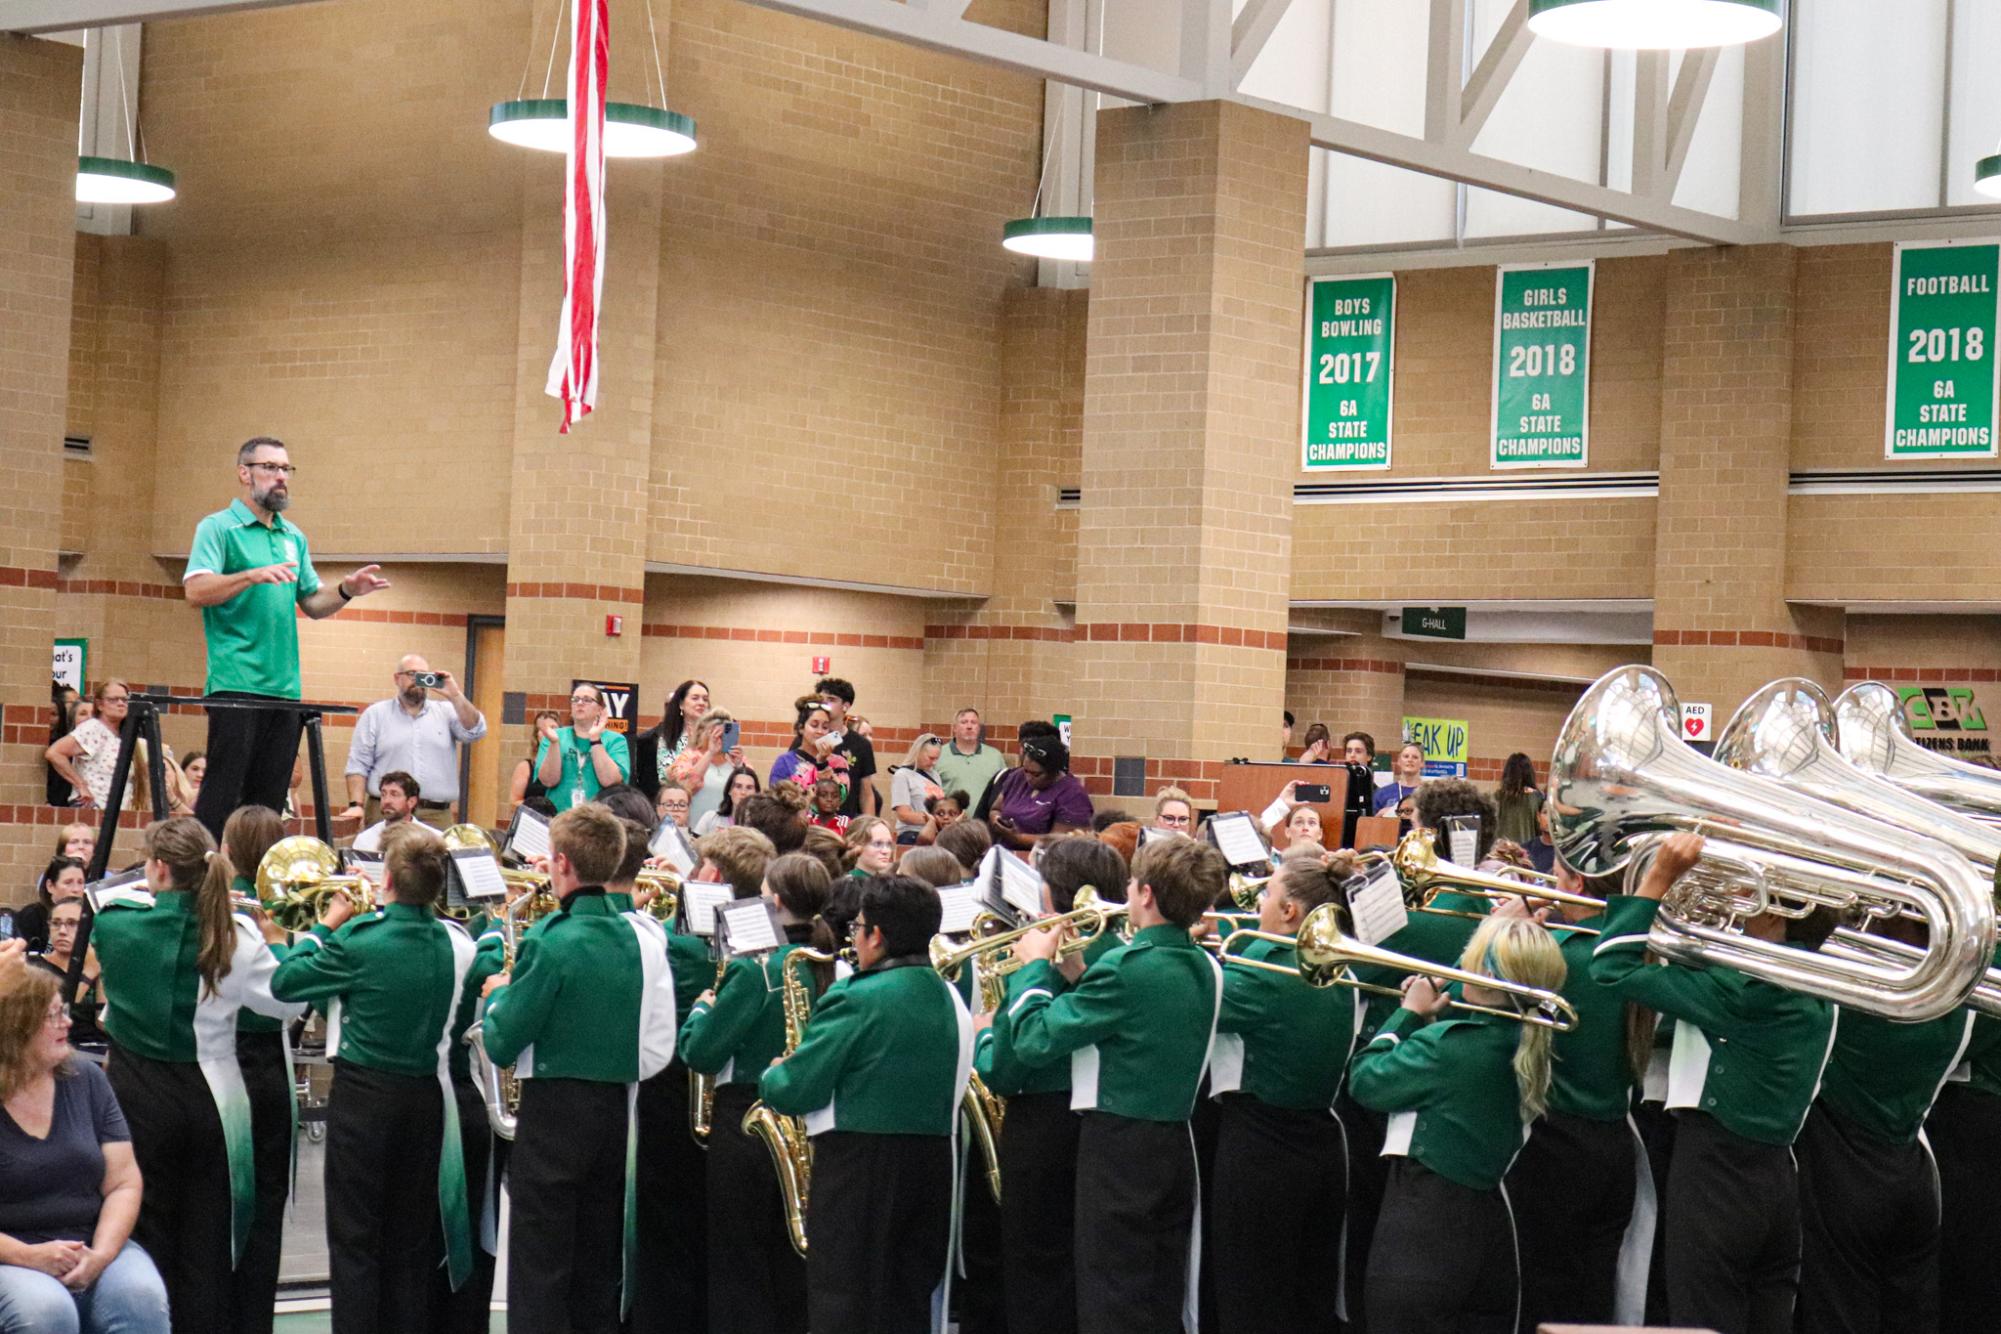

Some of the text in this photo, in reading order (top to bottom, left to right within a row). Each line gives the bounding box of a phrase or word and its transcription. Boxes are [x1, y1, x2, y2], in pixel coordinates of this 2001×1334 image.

[1907, 274, 1990, 296] FOOTBALL
[1334, 298, 1370, 315] BOYS
[1523, 288, 1567, 306] GIRLS
[1321, 319, 1382, 338] BOWLING
[1502, 309, 1586, 330] BASKETBALL
[1908, 327, 1984, 363] 2018
[1319, 351, 1381, 385] 2017
[1509, 343, 1576, 378] 2018
[1933, 380, 1955, 399] 6A
[1339, 400, 1357, 417] 6A
[1532, 394, 1550, 411] 6A
[1919, 403, 1967, 423] STATE
[1328, 420, 1367, 439] STATE
[1519, 415, 1561, 433] STATE
[1498, 437, 1582, 456] CHAMPIONS
[1895, 427, 1990, 447] CHAMPIONS
[1308, 441, 1387, 460] CHAMPIONS
[1421, 617, 1447, 630] G-HALL
[1685, 706, 1705, 715] AED
[1447, 725, 1464, 759] UP
[1957, 737, 1990, 752] BANK
